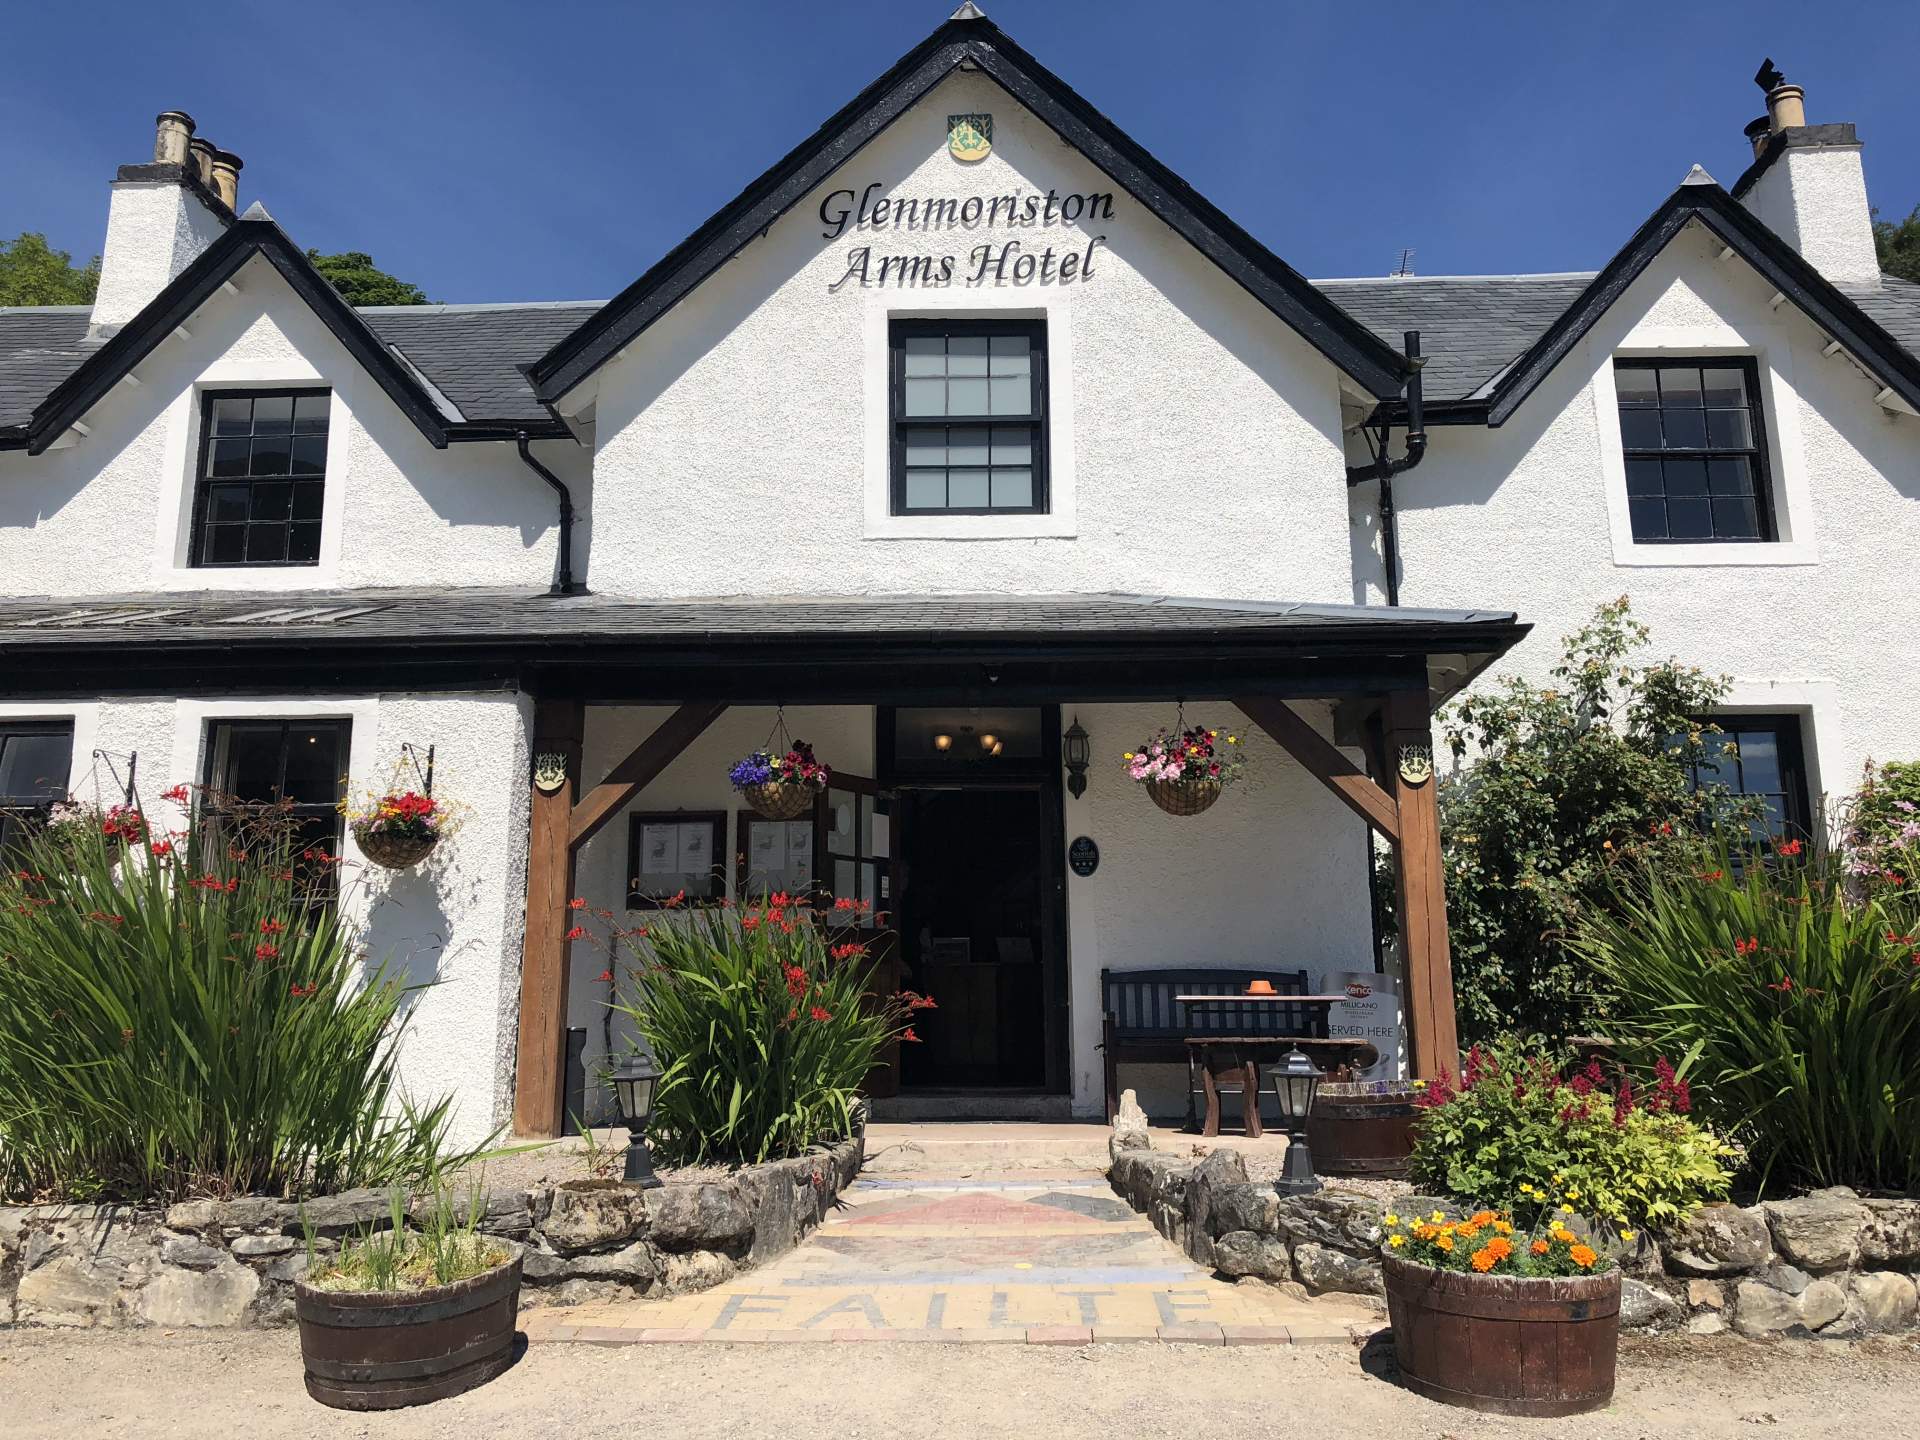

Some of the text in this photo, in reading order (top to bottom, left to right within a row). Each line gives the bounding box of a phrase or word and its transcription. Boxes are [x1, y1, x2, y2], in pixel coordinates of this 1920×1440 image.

[819, 183, 1113, 239] Glenmoriston
[828, 236, 1106, 288] Arms Hotel
[1345, 983, 1373, 995] Kenco
[1367, 1026, 1394, 1038] HERE
